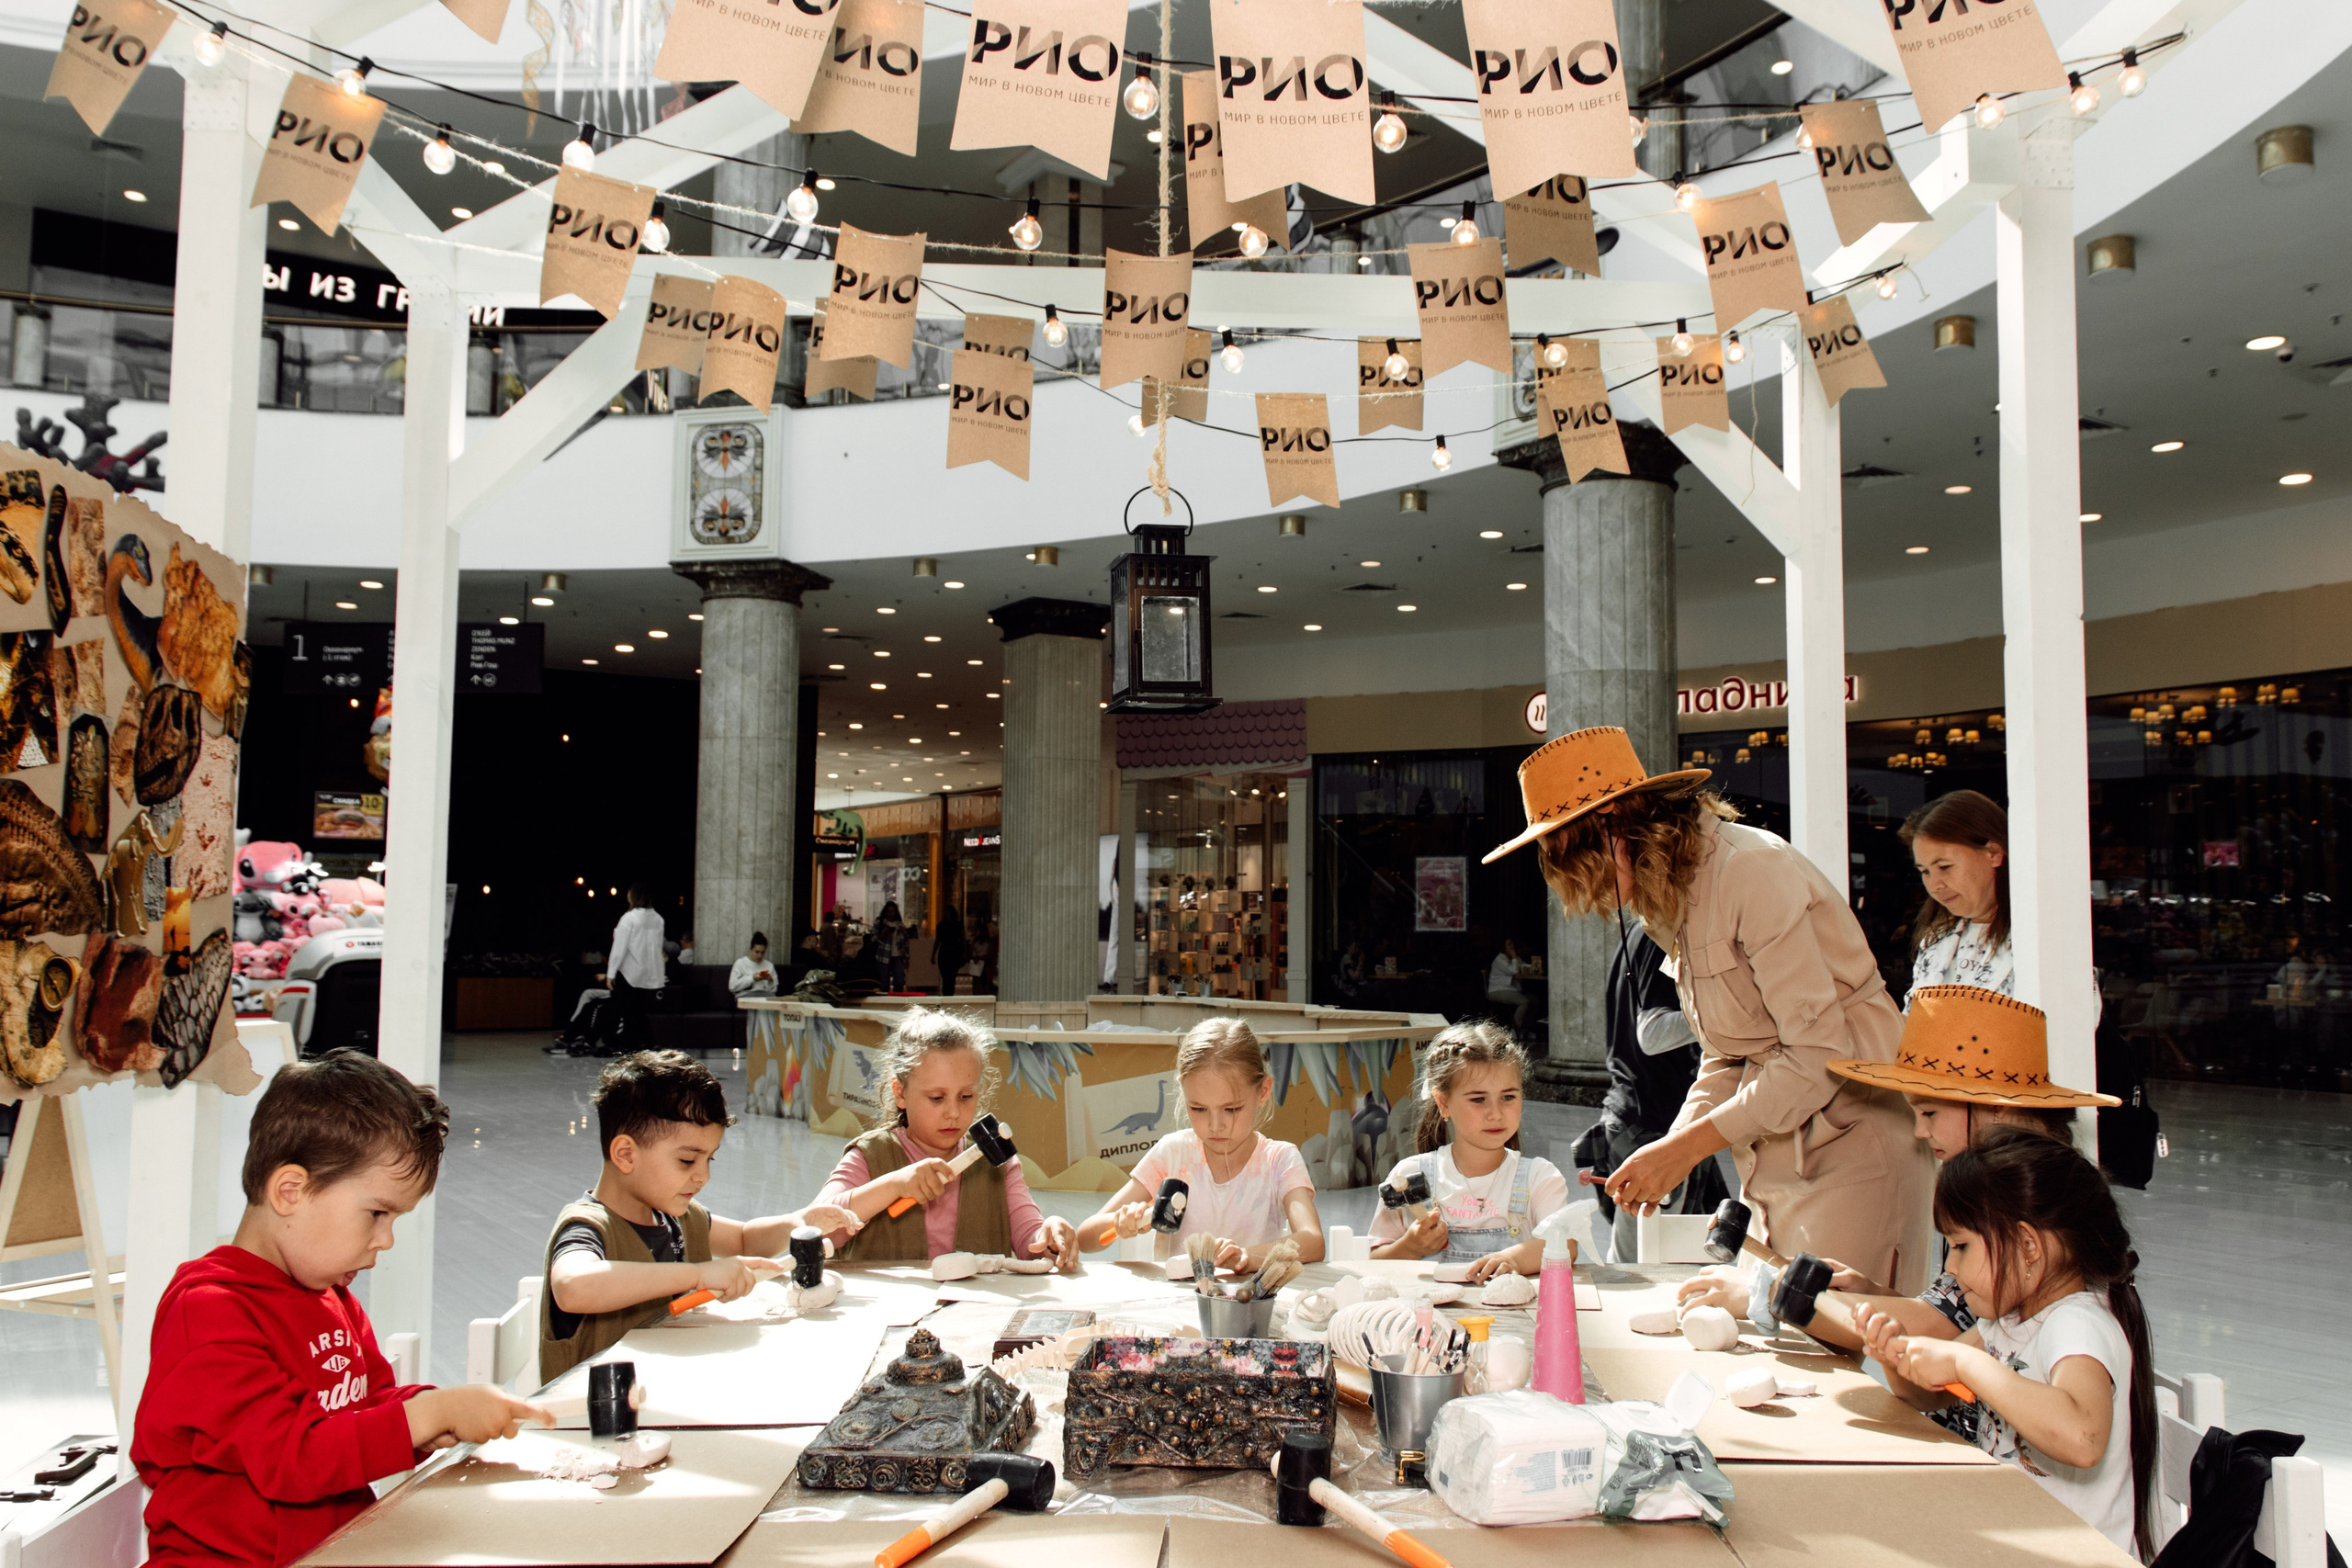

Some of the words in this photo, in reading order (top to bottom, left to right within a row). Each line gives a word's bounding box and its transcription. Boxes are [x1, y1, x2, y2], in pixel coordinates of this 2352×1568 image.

[718, 4, 729, 16] В
[732, 8, 780, 31] НОВОМ
[785, 24, 826, 41] ЦВЕТЕ
[1900, 41, 1922, 54] МИР
[1928, 37, 1935, 49] В
[1939, 25, 1984, 46] НОВОМ
[1989, 5, 2032, 30] ЦВЕТЕ
[828, 27, 919, 75] ИО
[971, 18, 1118, 81] РИО
[1219, 54, 1363, 101] РИО
[1475, 39, 1618, 95] РИО
[825, 70, 832, 78] В
[836, 74, 876, 89] НОВОМ
[879, 84, 916, 96] ЦВЕТЕ
[967, 75, 997, 87] МИР
[1002, 80, 1010, 90] В
[1015, 83, 1063, 99] НОВОМ
[1069, 92, 1112, 107] ЦВЕТЕ
[1224, 111, 1251, 123] МИР
[1257, 113, 1264, 124] В
[1270, 115, 1317, 125] НОВОМ
[1322, 110, 1365, 126] ЦВЕТЕ
[1485, 107, 1509, 118] МИР
[1515, 109, 1522, 118] В
[1527, 103, 1574, 118] НОВОМ
[1579, 91, 1622, 111] ЦВЕТЕ
[272, 109, 364, 164] РИО
[1189, 168, 1208, 180] МИР
[1211, 168, 1217, 176] В
[1815, 142, 1894, 177] РИО
[548, 203, 639, 250] РИО
[1506, 201, 1521, 212] МИР
[1532, 209, 1560, 218] НОВОМ
[1562, 211, 1589, 221] ЦВЕТЕ
[569, 246, 598, 259] НОВОМ
[600, 254, 629, 268] ЦВЕТЕ
[1702, 220, 1791, 265] РИО
[1738, 262, 1769, 274] НОВОМ
[1770, 254, 1796, 267] ЦВЕТЕ
[310, 272, 356, 303] ИЗ
[834, 264, 919, 304] РИО
[1416, 275, 1503, 310] РИО
[831, 300, 848, 310] МИР
[859, 310, 889, 320] НОВОМ
[892, 310, 914, 321] ЦВЕТЕ
[1105, 290, 1189, 323] РИО
[1480, 313, 1505, 321] ЦВЕТЕ
[707, 312, 779, 353] РИО
[1104, 328, 1122, 337] МИР
[1133, 331, 1163, 340] НОВОМ
[1165, 326, 1186, 337] ЦВЕТЕ
[1808, 323, 1862, 359] РИО
[1661, 363, 1724, 386] РИО
[953, 384, 1030, 421] РИО
[1553, 401, 1611, 432] РИО
[952, 416, 967, 424] МИР
[978, 422, 1003, 431] НОВОМ
[1006, 426, 1028, 435] ЦВЕТЕ
[1261, 427, 1330, 452] РИО
[292, 635, 309, 660] 1
[784, 1013, 802, 1022] ТОПАЗ
